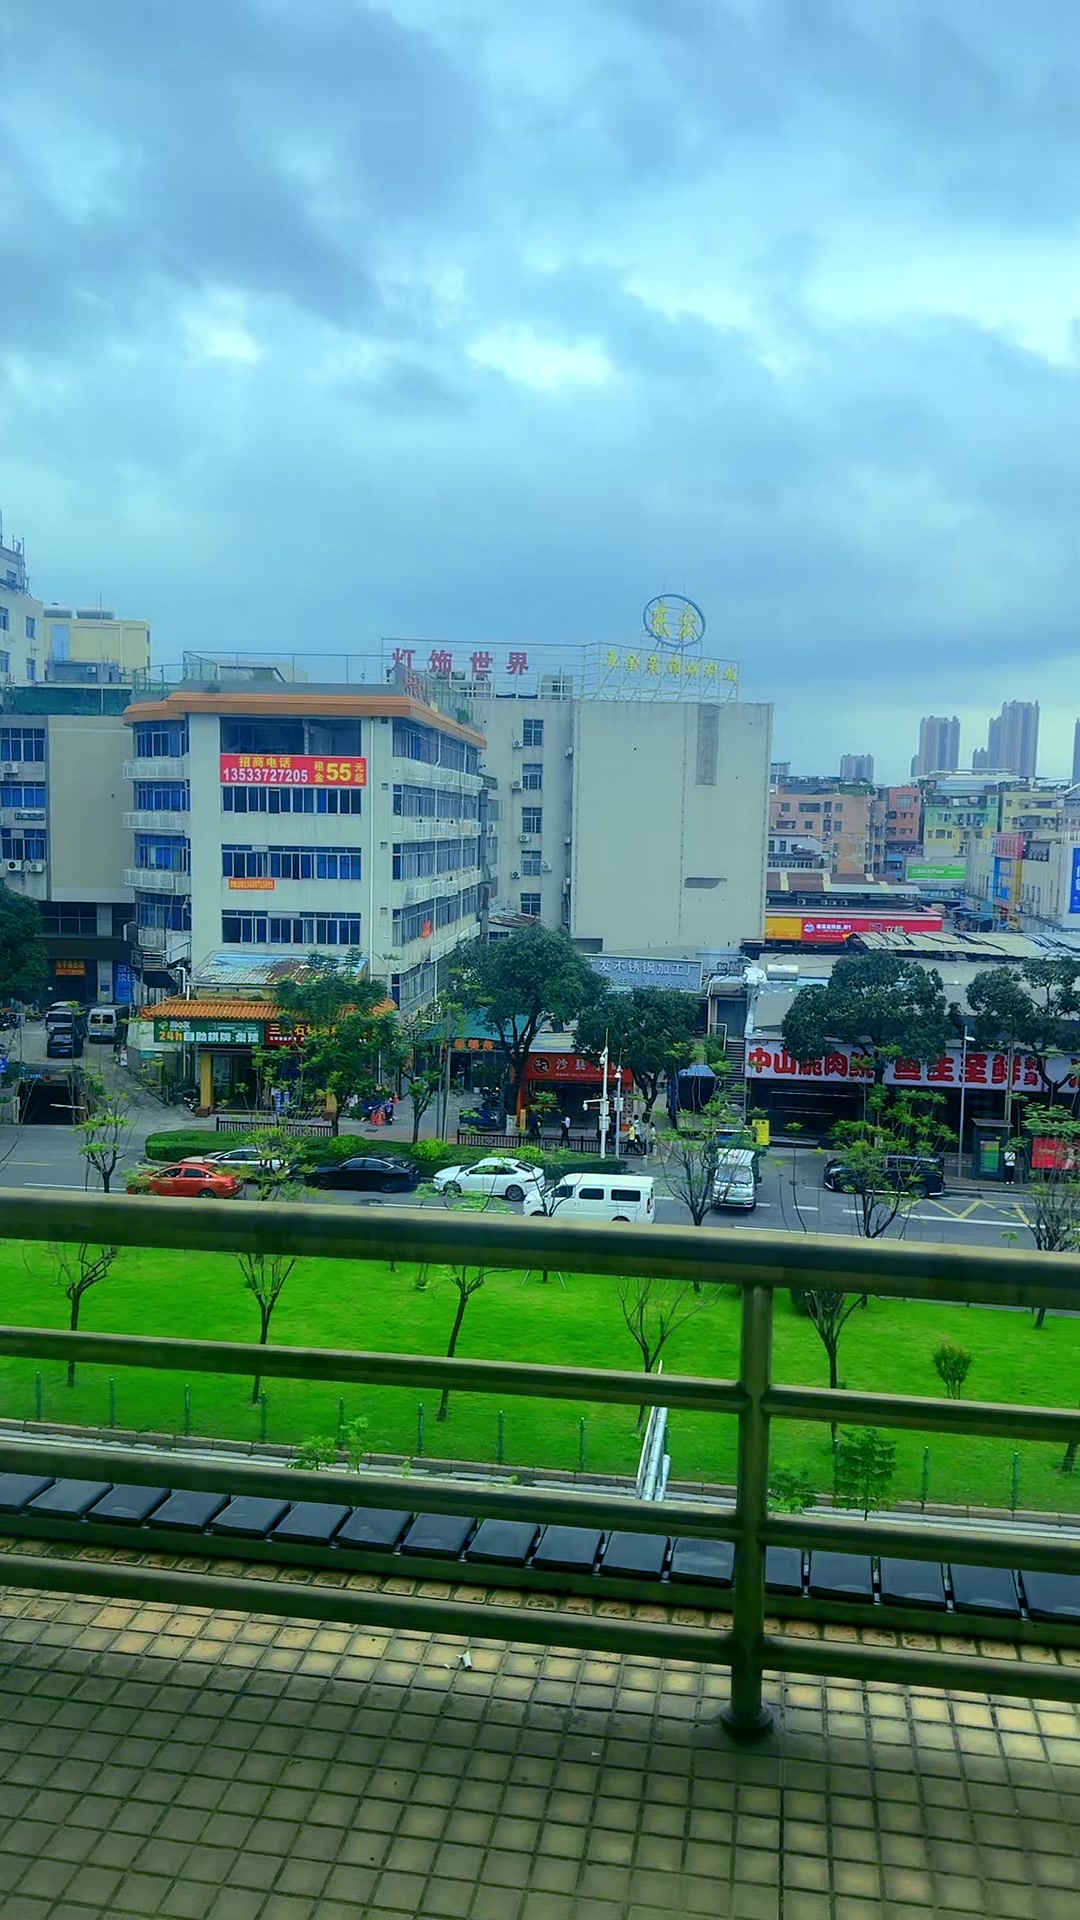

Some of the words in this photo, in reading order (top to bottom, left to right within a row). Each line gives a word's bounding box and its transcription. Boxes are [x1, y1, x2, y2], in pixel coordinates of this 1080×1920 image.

[392, 648, 529, 676] 灯饰世界
[238, 756, 291, 769] 招商电话
[223, 768, 309, 783] 13533727205
[326, 763, 352, 782] 55
